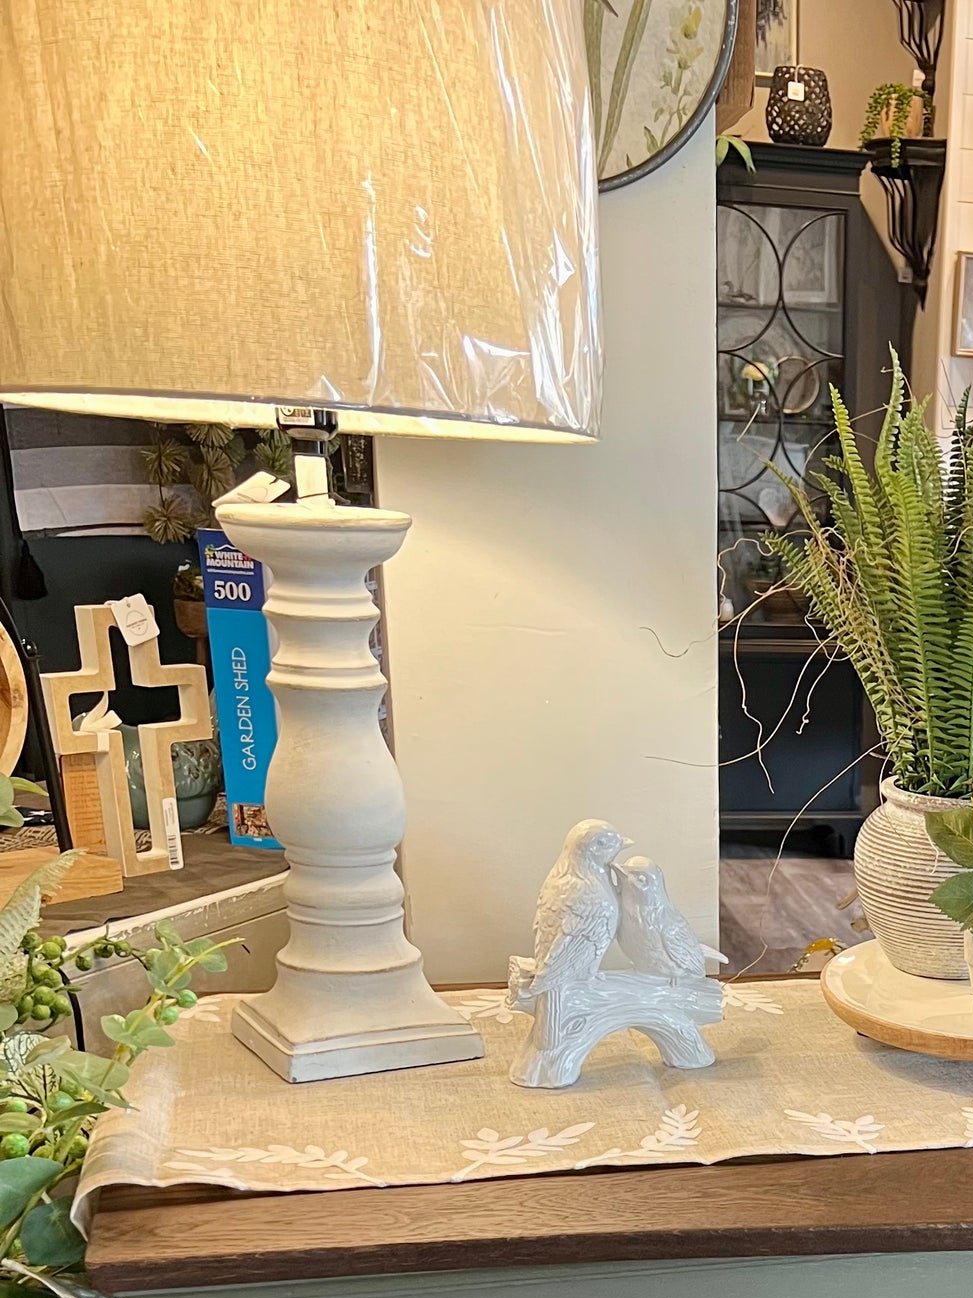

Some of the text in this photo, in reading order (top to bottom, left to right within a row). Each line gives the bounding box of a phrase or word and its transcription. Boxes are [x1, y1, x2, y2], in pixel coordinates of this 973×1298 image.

[206, 558, 255, 570] MOUNTAIN
[213, 551, 243, 561] WHITE
[213, 580, 252, 602] 500
[231, 646, 257, 771] GARDEN SHED
